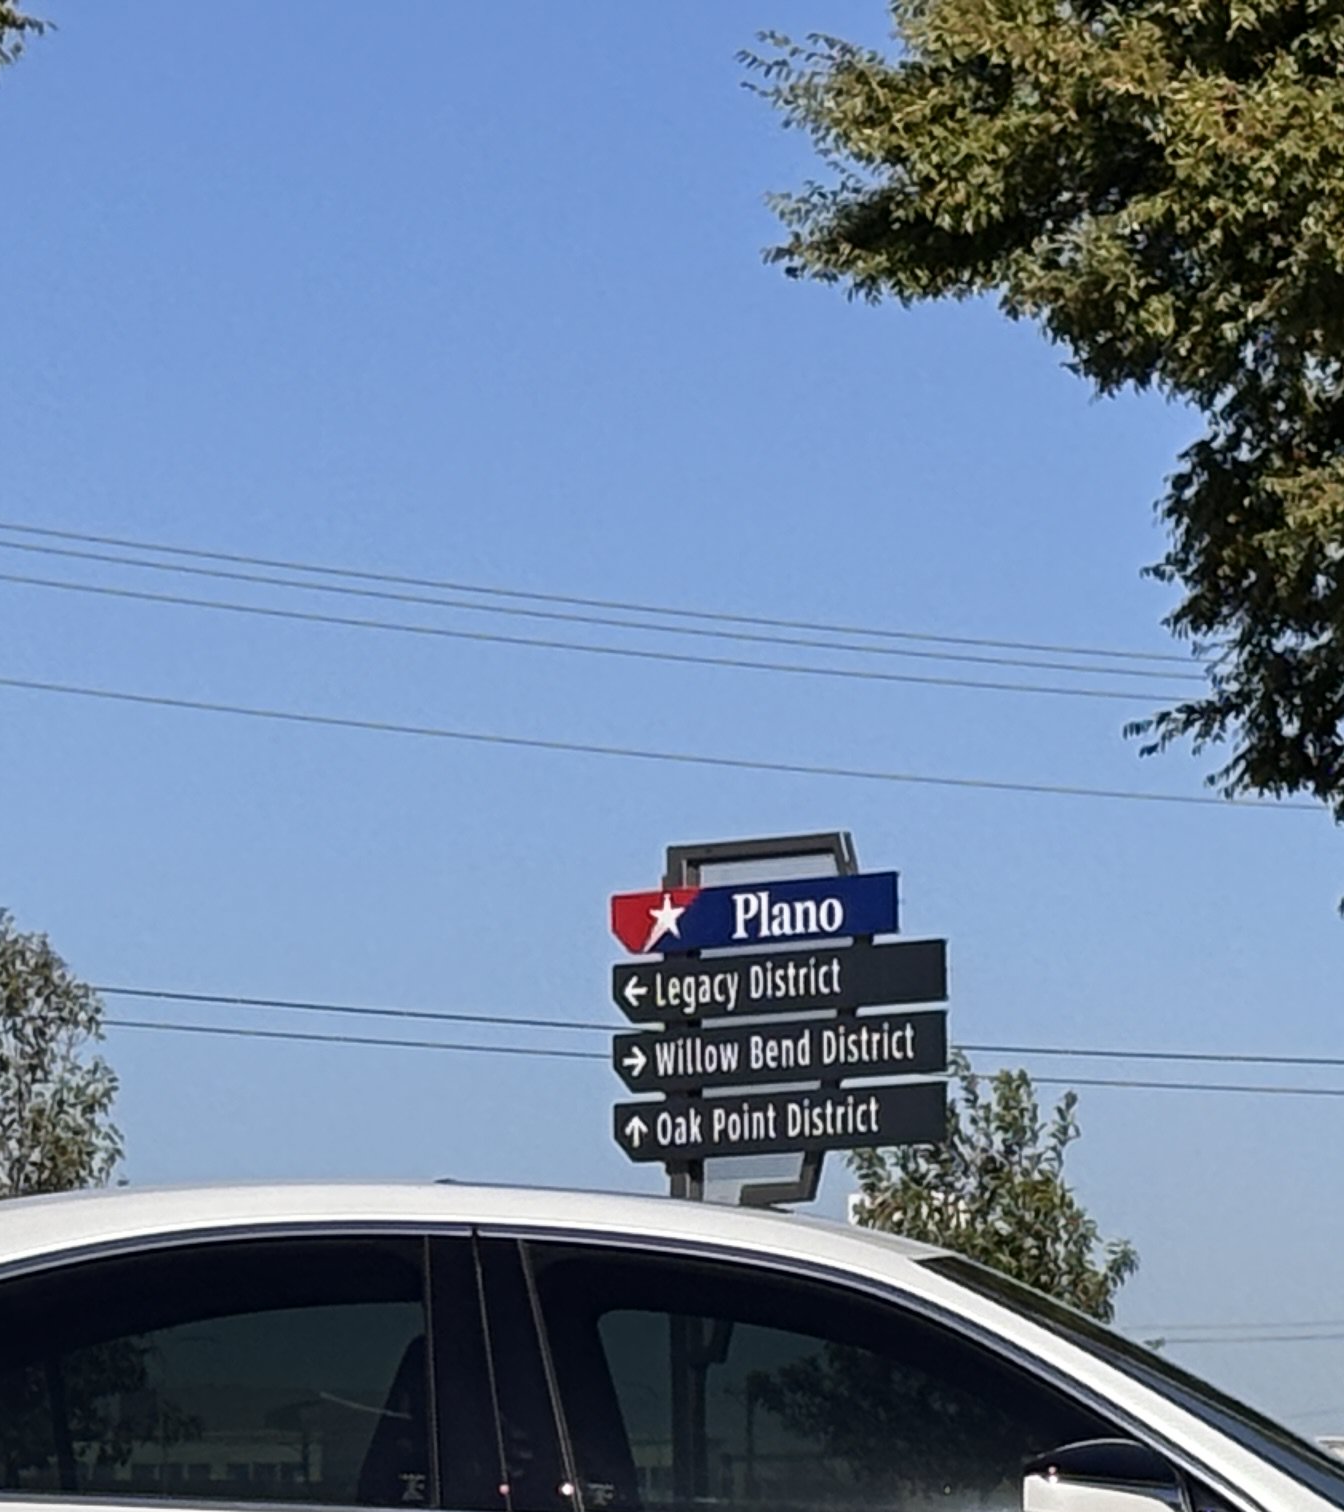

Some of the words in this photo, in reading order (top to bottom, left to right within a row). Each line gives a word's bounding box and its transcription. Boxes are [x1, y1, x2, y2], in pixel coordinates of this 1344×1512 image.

[732, 892, 843, 938] Plano
[656, 972, 738, 1014] Legacy
[751, 957, 841, 997] District
[656, 1038, 738, 1076] Willow
[751, 1030, 810, 1069] Bend
[823, 1023, 914, 1064] District
[657, 1108, 702, 1145] Oak
[714, 1103, 775, 1141] Point
[788, 1096, 879, 1137] District
